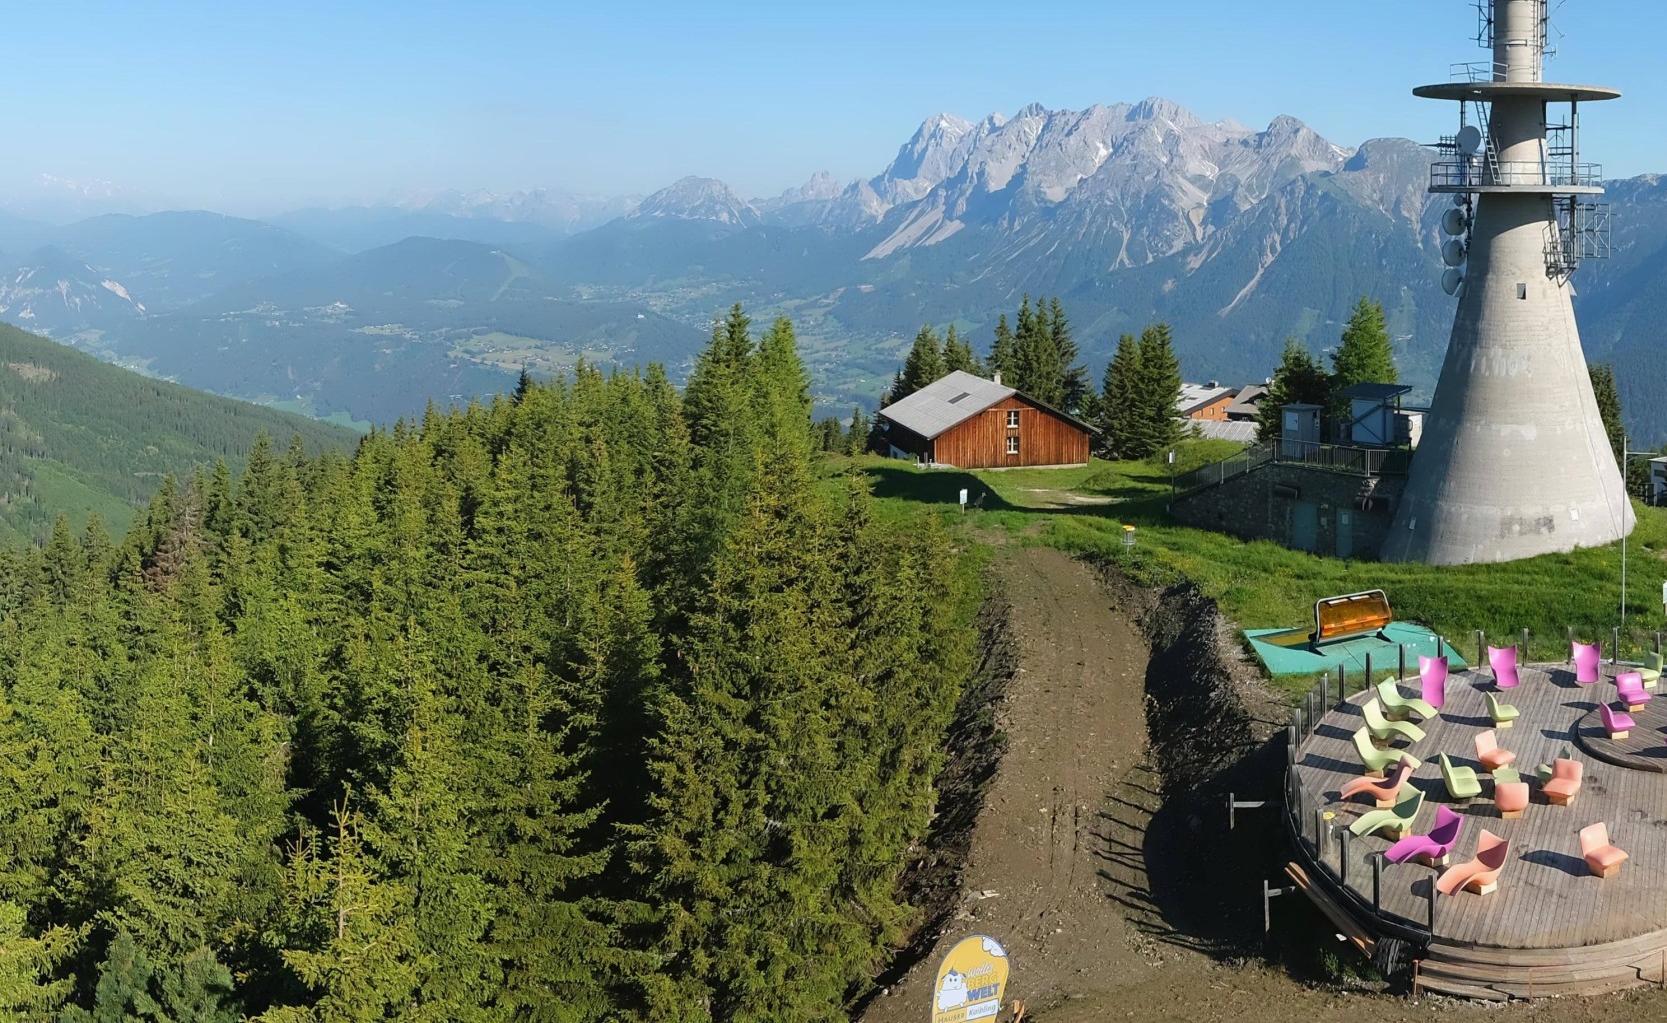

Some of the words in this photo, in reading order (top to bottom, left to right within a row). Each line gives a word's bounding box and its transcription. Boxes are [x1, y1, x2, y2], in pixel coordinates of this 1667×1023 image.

[967, 973, 998, 989] BERG
[967, 982, 1000, 1002] WELT
[969, 1005, 996, 1017] Kaibling
